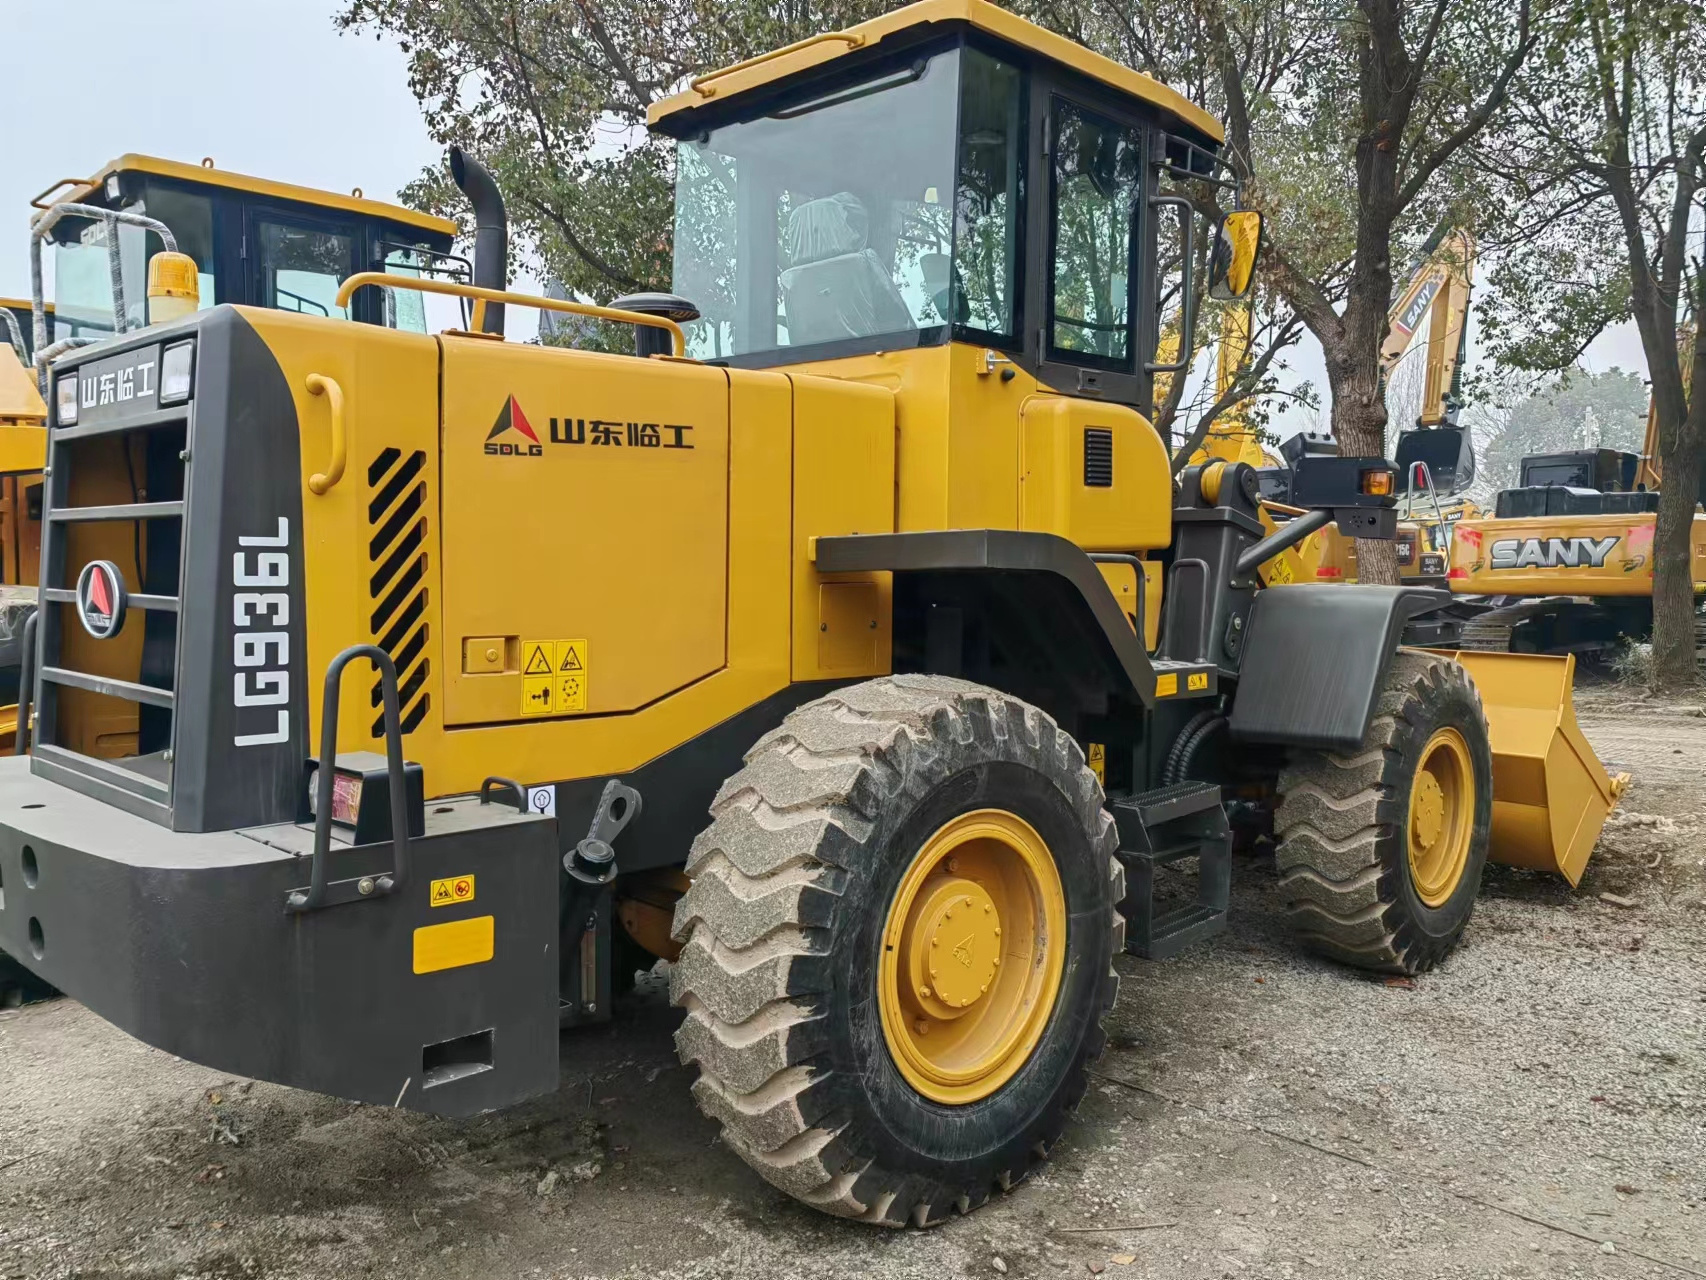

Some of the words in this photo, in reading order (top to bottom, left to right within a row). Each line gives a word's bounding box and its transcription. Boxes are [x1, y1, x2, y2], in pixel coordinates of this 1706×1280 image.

[1406, 283, 1431, 328] SANY
[82, 361, 155, 408] 山东临工
[484, 442, 542, 456] SDLG
[550, 417, 694, 449] 山东临工
[1491, 537, 1619, 568] SANY
[233, 516, 289, 747] LG936L
